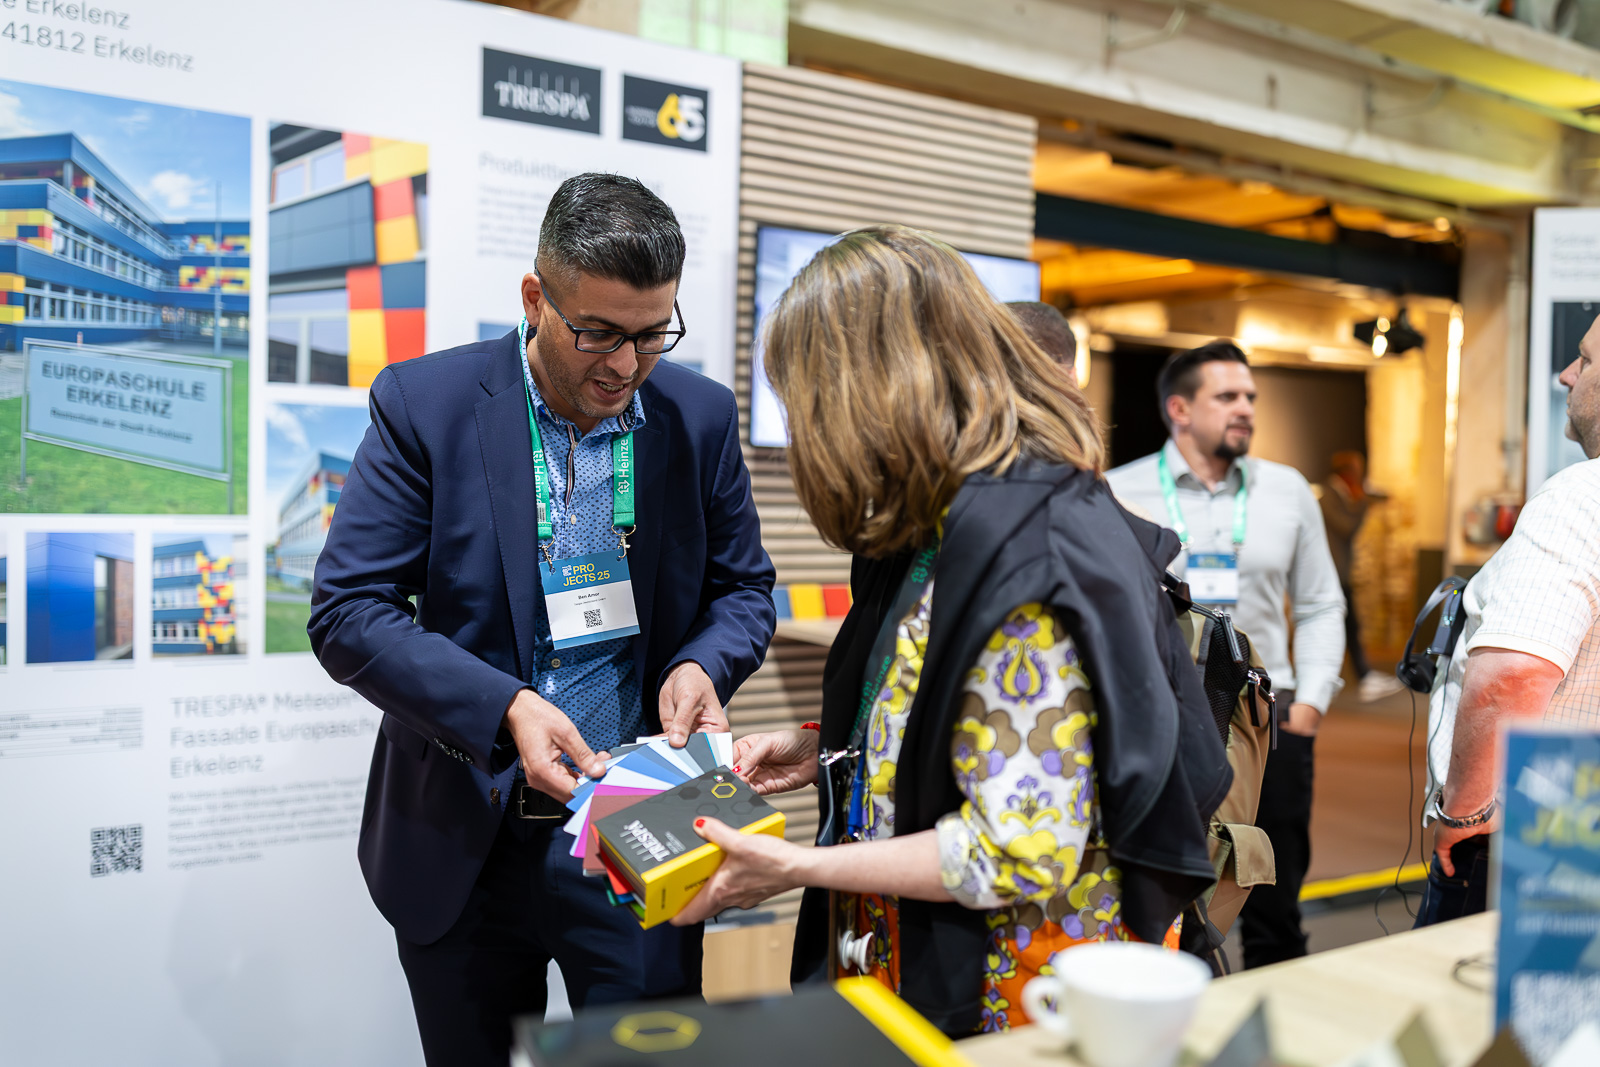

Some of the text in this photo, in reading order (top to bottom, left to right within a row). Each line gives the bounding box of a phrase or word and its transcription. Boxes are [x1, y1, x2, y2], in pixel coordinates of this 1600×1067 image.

[26, 0, 131, 30] Erkelenz
[1, 21, 195, 73] 41812 Erkelenz
[656, 93, 706, 142] 65
[41, 360, 208, 402] EUROPASCHULE
[66, 385, 173, 420] ERKELENZ
[618, 439, 630, 477] Heinze
[563, 570, 611, 587] JECTS 25
[572, 563, 595, 575] PRO
[169, 723, 260, 749] Fassade
[169, 754, 265, 779] Erkelenz
